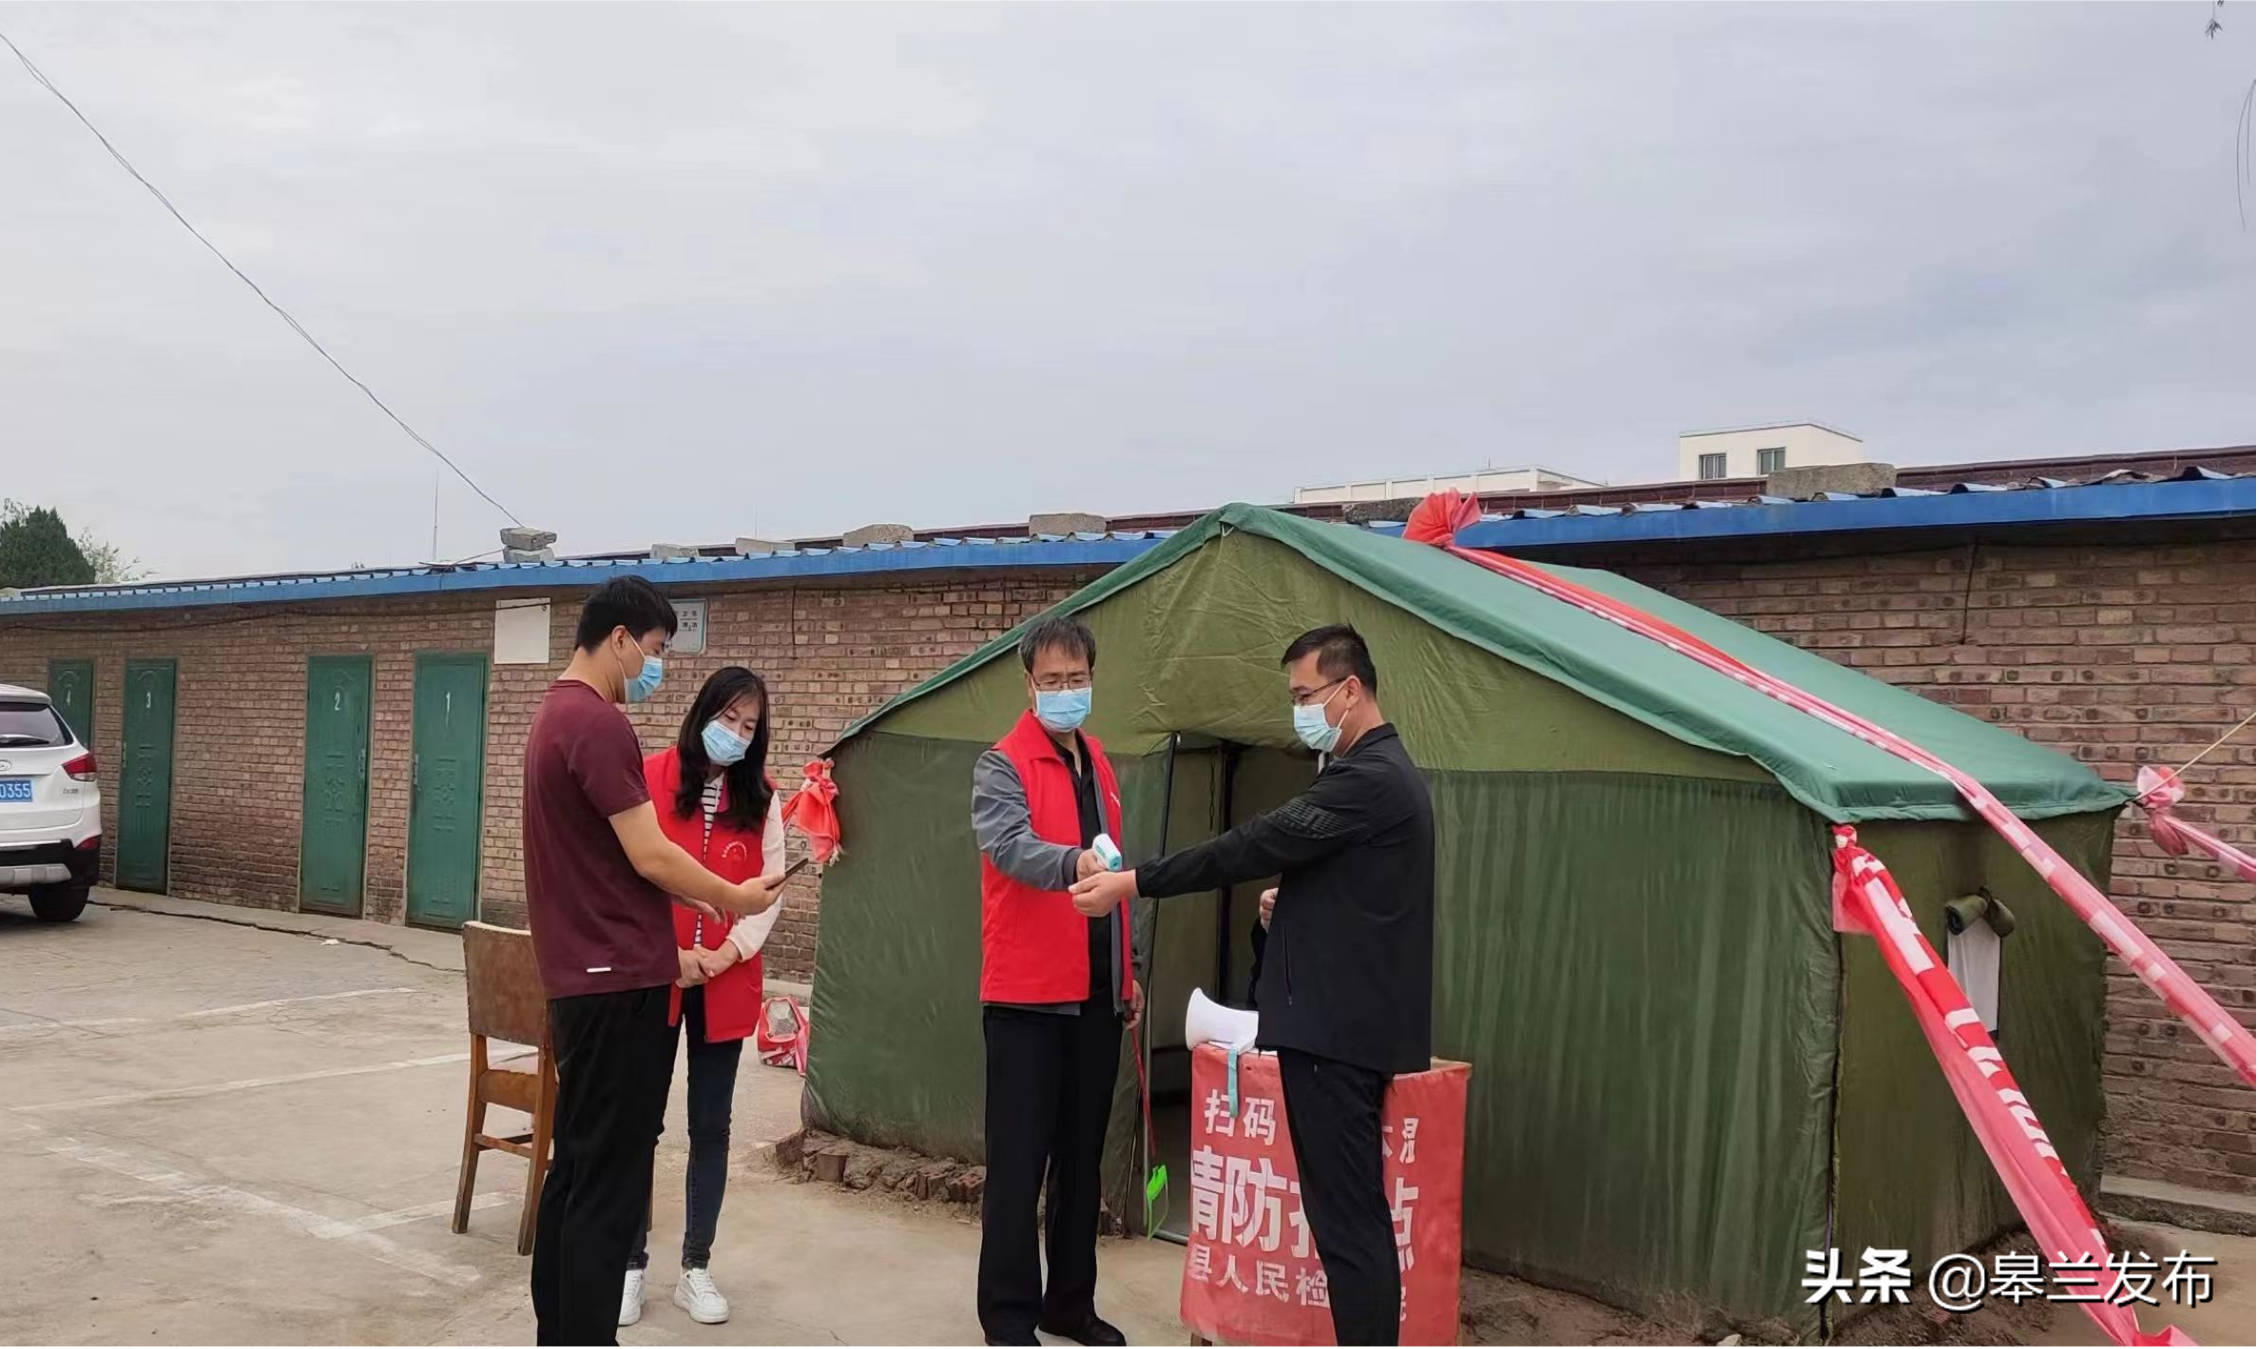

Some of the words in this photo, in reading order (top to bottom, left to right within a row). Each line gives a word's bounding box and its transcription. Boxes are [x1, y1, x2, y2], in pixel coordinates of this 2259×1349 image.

[145, 691, 152, 709] 3
[334, 692, 341, 711] 2
[1204, 1088, 1276, 1146] 扫码
